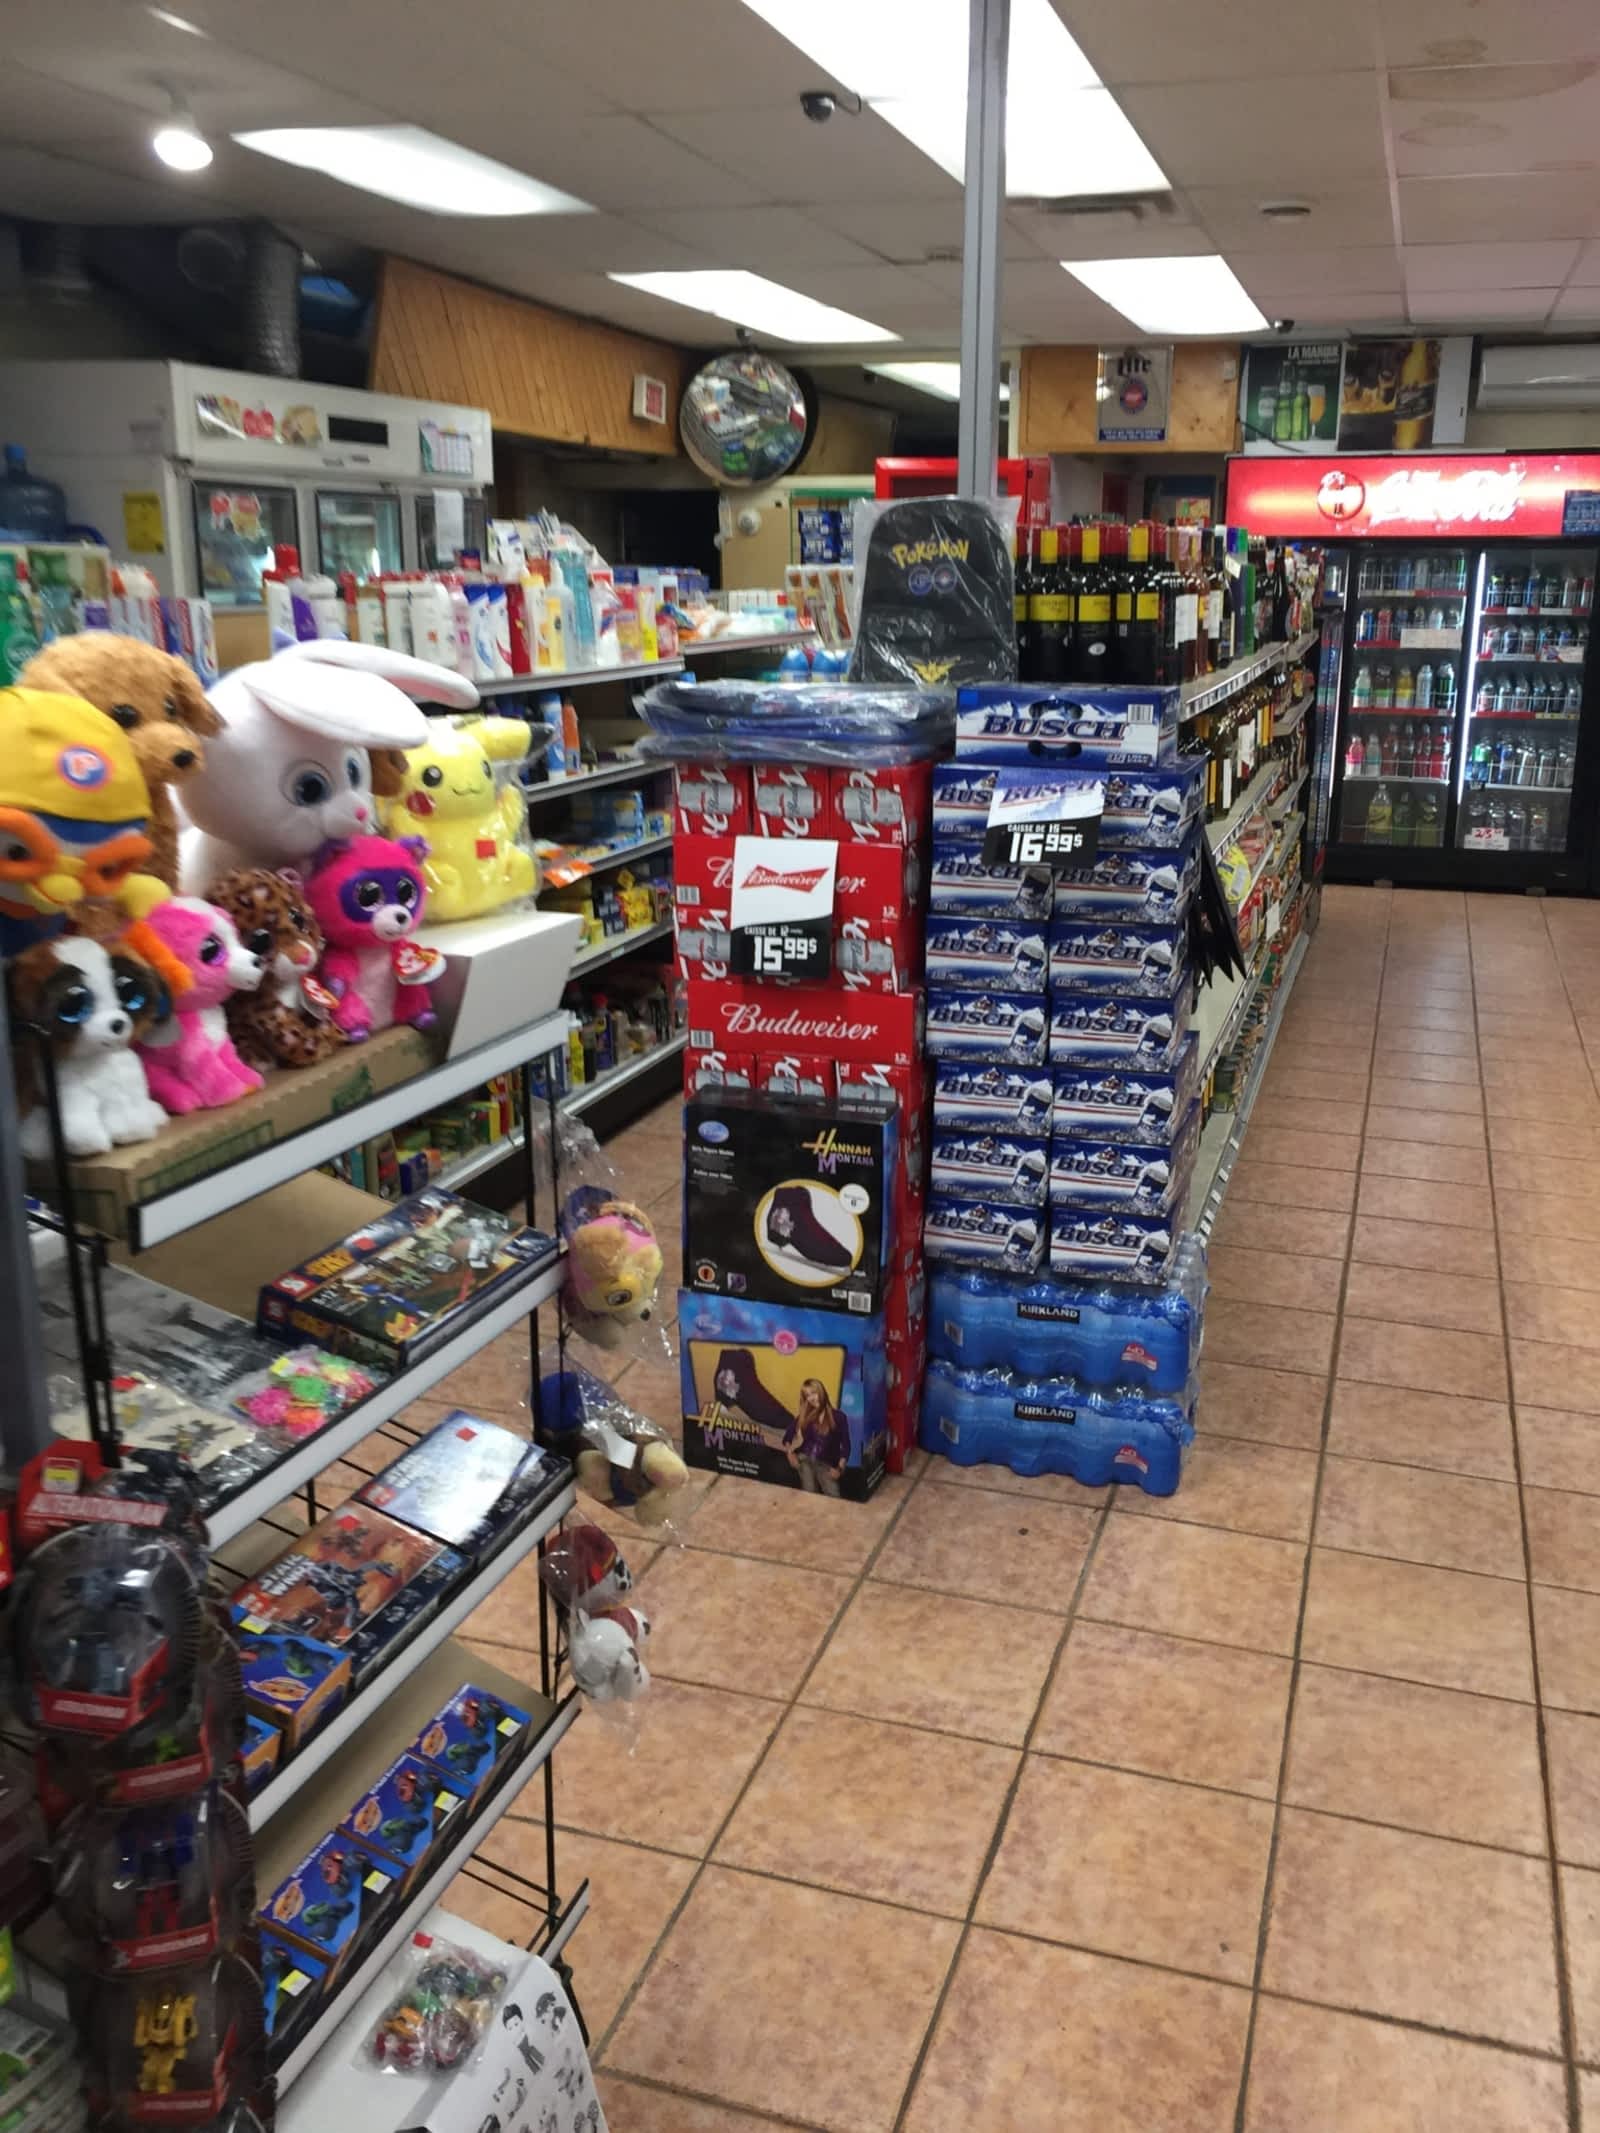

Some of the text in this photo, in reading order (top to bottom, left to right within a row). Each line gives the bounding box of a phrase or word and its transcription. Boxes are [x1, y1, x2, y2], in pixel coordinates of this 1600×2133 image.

[981, 714, 1129, 740] BUSCH
[934, 788, 994, 803] BUS
[1001, 780, 1103, 803] BUSCH
[1007, 824, 1034, 833] CAISSE
[1035, 824, 1046, 833] DE
[749, 869, 820, 887] Budweiser
[936, 861, 1022, 880] BUSCH
[1057, 866, 1148, 888] BUSCH
[768, 927, 777, 937] DE
[931, 936, 1016, 955] BUSCH
[1055, 940, 1142, 961] BUSCH
[720, 1002, 879, 1041] Budweiser
[930, 1008, 1015, 1029] BUSCH
[1056, 1014, 1143, 1035] BUSCH
[940, 1079, 1027, 1100] BUSCH
[1060, 1086, 1147, 1108] BUSCH
[801, 1128, 872, 1157] HANNAH
[818, 1152, 875, 1175] MONTANA
[935, 1146, 1020, 1167] BUSCH
[1056, 1157, 1142, 1180] BUSCH
[929, 1213, 1013, 1236] BUSCH
[1057, 1227, 1142, 1249] BUSCH
[1020, 1303, 1079, 1319] KIRKLAND
[686, 1401, 761, 1433] HANNAH
[1016, 1404, 1075, 1420] KIRKLAND
